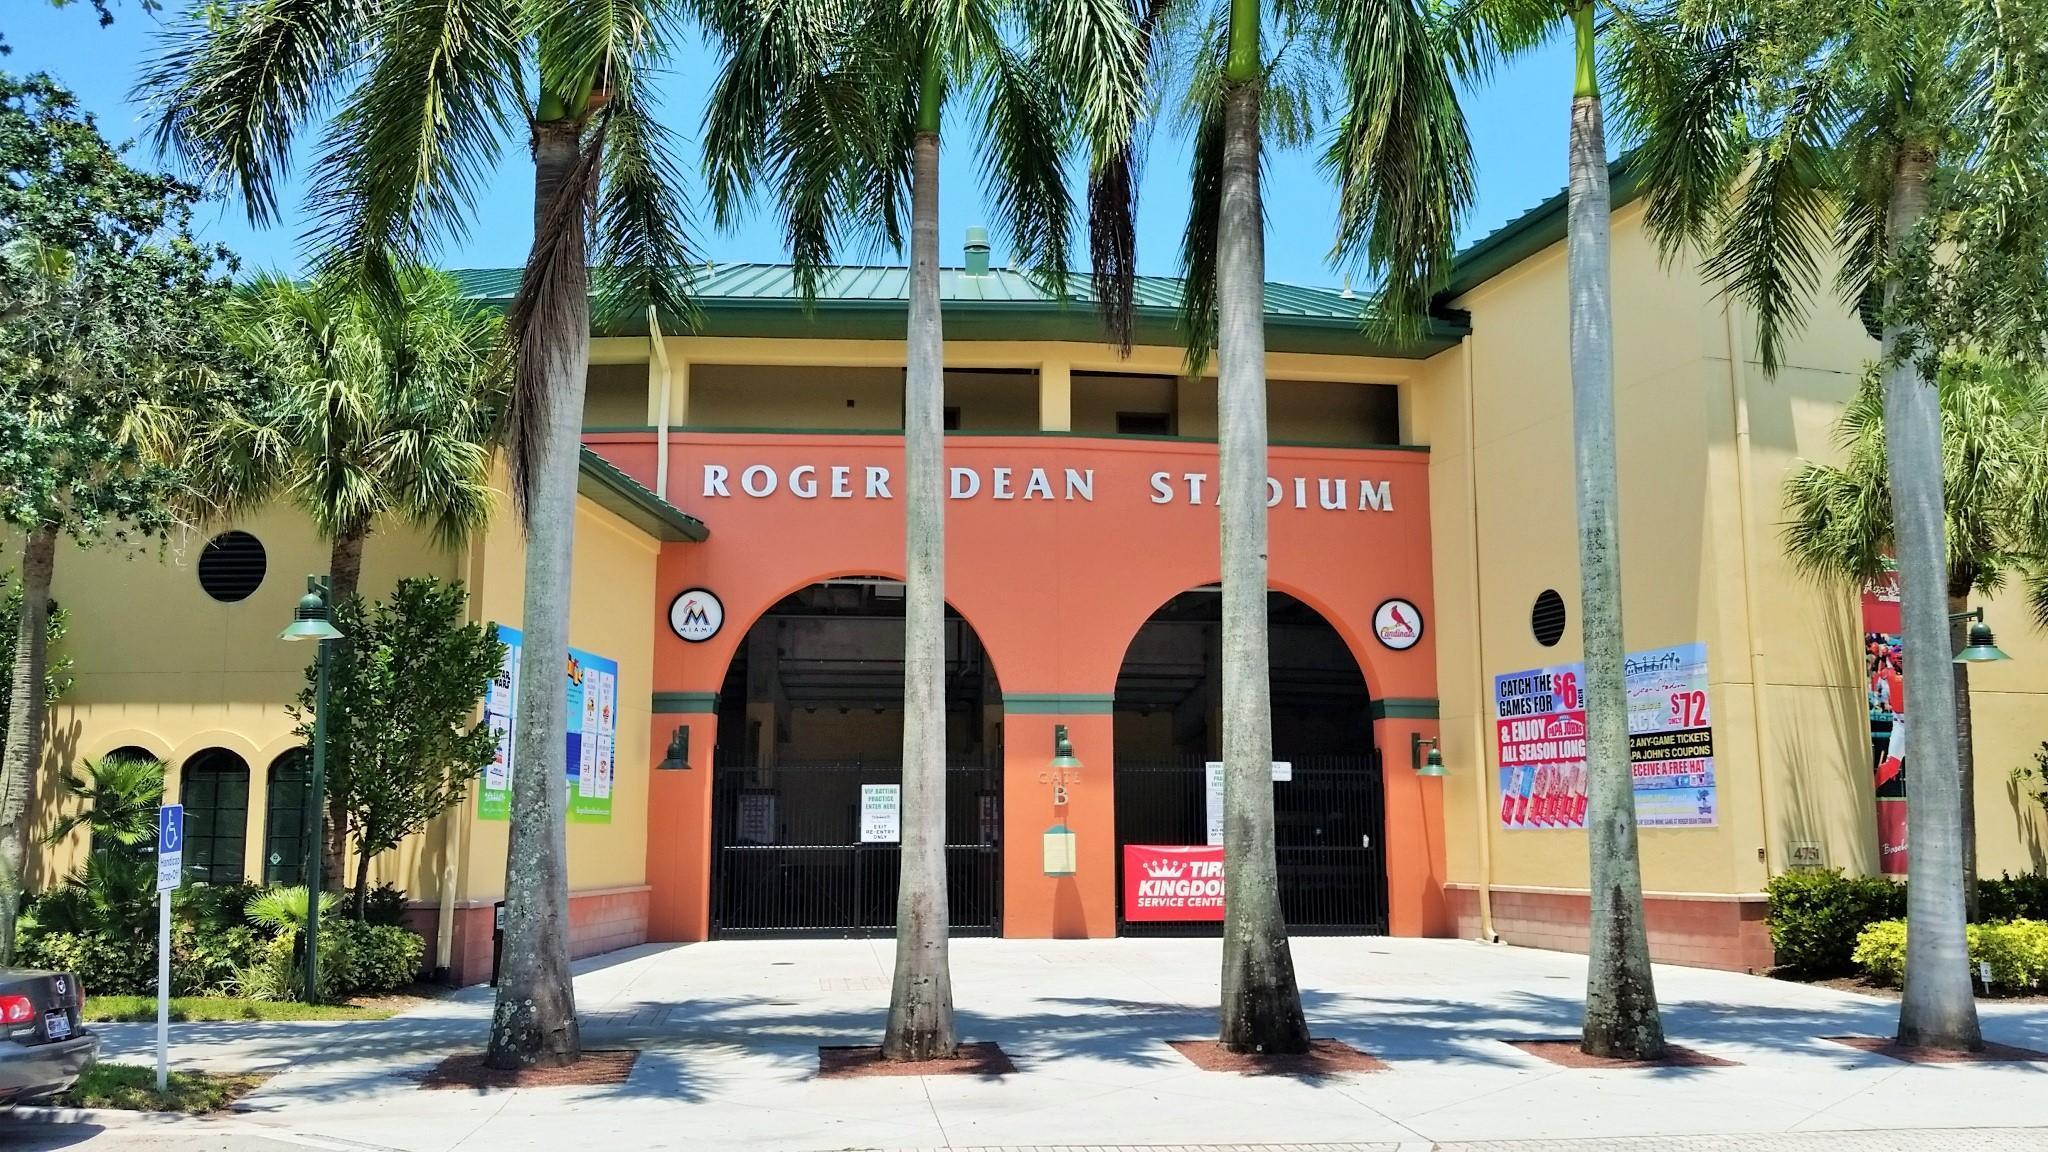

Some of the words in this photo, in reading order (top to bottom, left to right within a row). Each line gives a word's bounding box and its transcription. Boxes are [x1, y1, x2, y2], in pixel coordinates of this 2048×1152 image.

[702, 464, 893, 499] ROGER
[948, 467, 1094, 501] DEAN
[1150, 471, 1395, 511] STDIUM
[494, 678, 511, 690] WARS
[1501, 677, 1531, 697] CATCH
[1533, 674, 1552, 693] THE
[1552, 672, 1577, 710] $6
[1499, 697, 1532, 718] GAMES
[1533, 694, 1553, 713] FOR
[1670, 690, 1707, 728] $72
[1501, 725, 1511, 743] &
[1511, 718, 1546, 742] ENJOY
[1628, 711, 1660, 732] ACK
[1630, 738, 1635, 748] 2
[1635, 734, 1676, 747] ANY-GAME
[1676, 731, 1710, 744] TICKETS
[1502, 745, 1518, 763] ALL
[1518, 741, 1558, 762] SEASON
[1559, 738, 1586, 759] LONG
[1631, 751, 1642, 760] PA
[1642, 748, 1671, 760] JOHN'S
[1671, 745, 1711, 757] COUPONS
[1039, 771, 1081, 784] GATE
[1632, 763, 1660, 777] ECEIVE
[1661, 763, 1668, 775] A
[1669, 760, 1688, 774] FREE
[1689, 759, 1705, 773] HAT
[1053, 785, 1069, 806] B
[1794, 846, 1820, 861] 4751
[1189, 861, 1225, 878] TIR
[1137, 897, 1184, 907] SERVICE
[1187, 897, 1224, 907] CENTE
